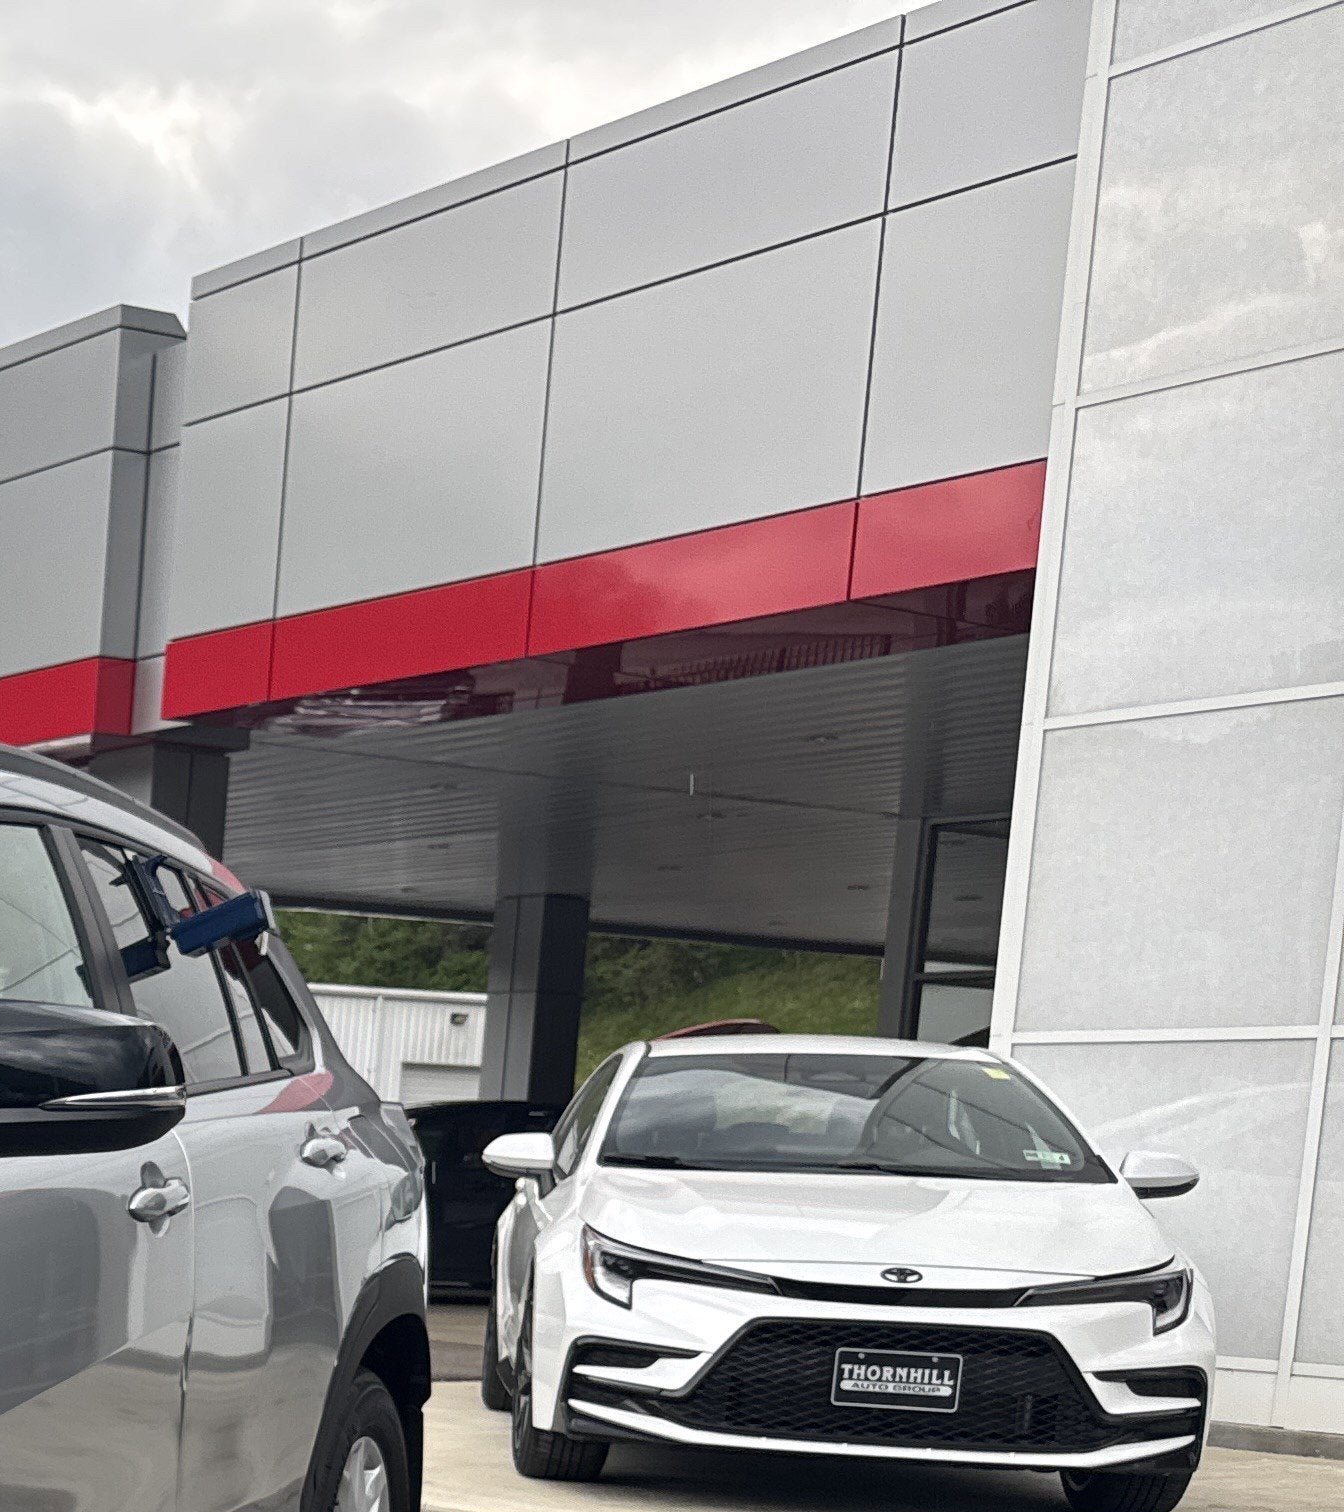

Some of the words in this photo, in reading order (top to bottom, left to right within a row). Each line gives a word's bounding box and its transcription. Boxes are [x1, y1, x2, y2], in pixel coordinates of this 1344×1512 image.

[840, 1363, 954, 1386] THORNHILL
[851, 1382, 888, 1391] AUTO
[892, 1384, 941, 1394] GROUP
